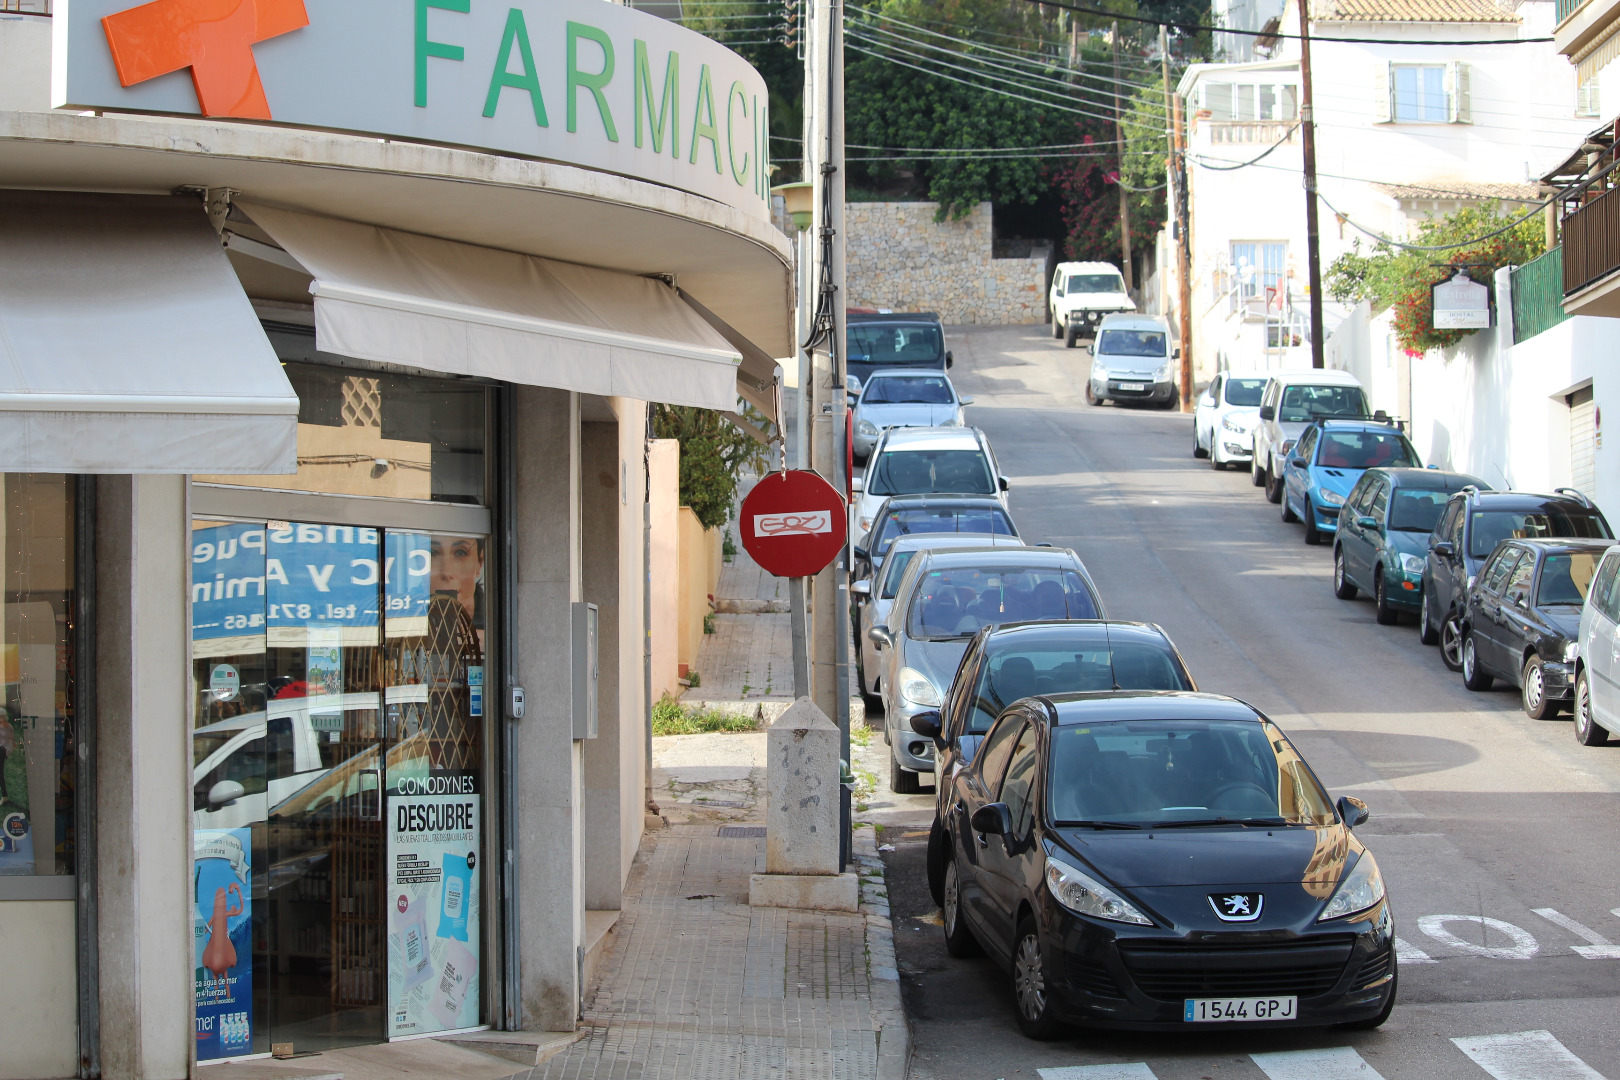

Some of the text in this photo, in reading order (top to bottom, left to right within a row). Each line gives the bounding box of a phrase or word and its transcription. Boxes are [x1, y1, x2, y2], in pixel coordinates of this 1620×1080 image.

[397, 775, 474, 795] COMODYNES
[397, 803, 474, 833] DESCUBRE
[397, 899, 408, 908] NEW
[203, 978, 217, 989] agua
[218, 977, 225, 985] de
[226, 977, 238, 985] mar
[206, 988, 227, 997] fuerzas
[1199, 1001, 1248, 1019] 1544
[1255, 999, 1293, 1018] GPJ
